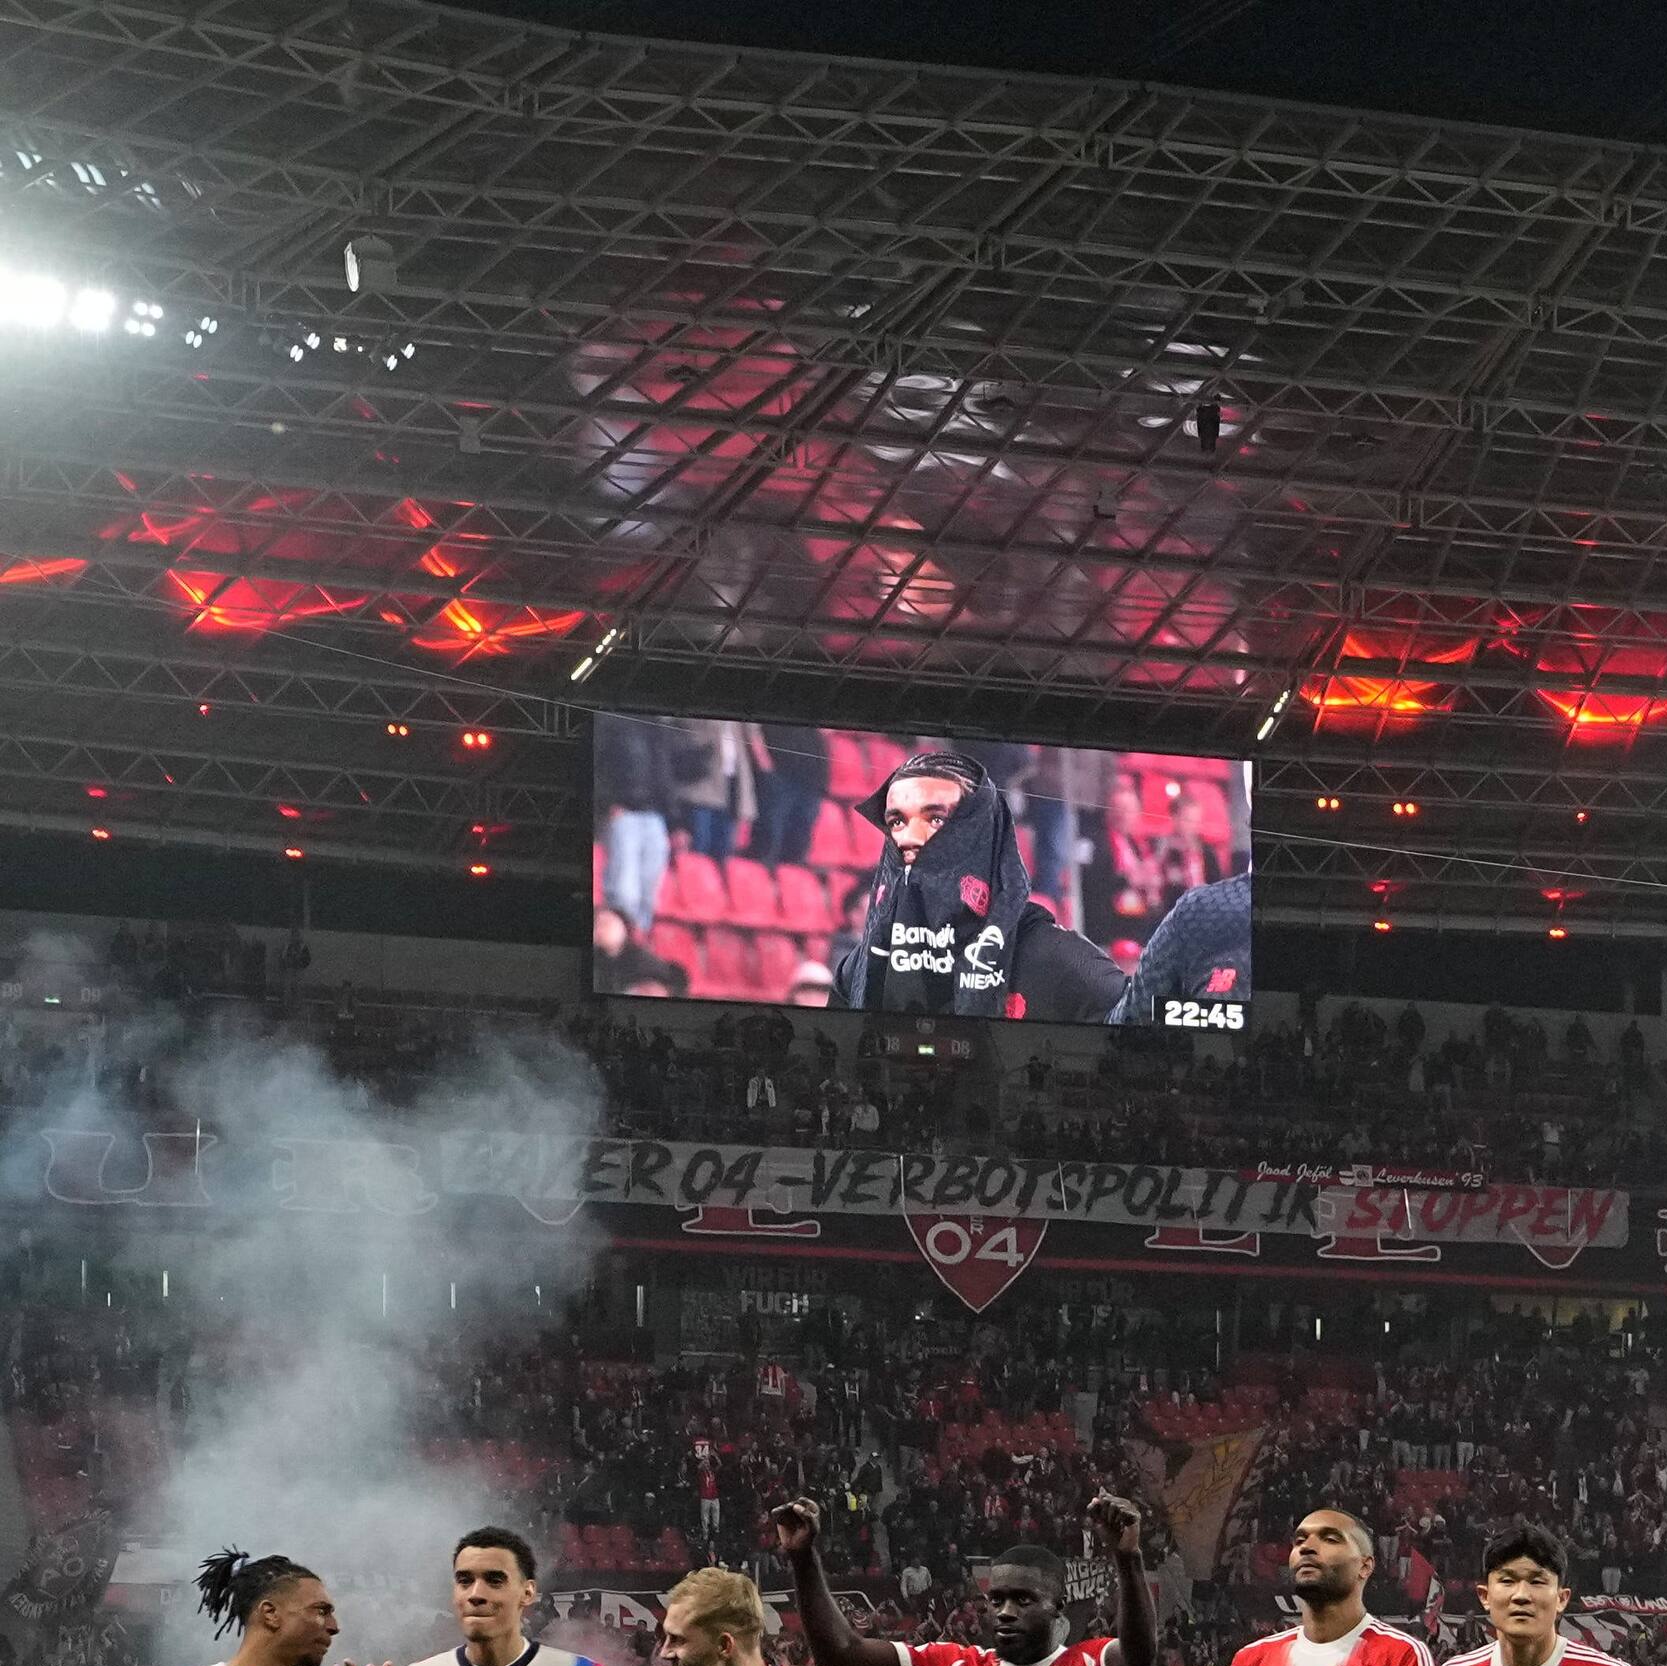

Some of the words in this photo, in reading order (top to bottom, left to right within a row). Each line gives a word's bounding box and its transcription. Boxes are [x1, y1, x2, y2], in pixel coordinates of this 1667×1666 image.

[1165, 1000, 1244, 1029] 22:45
[1346, 1186, 1618, 1242] STOPPEN
[925, 1220, 1025, 1268] 04
